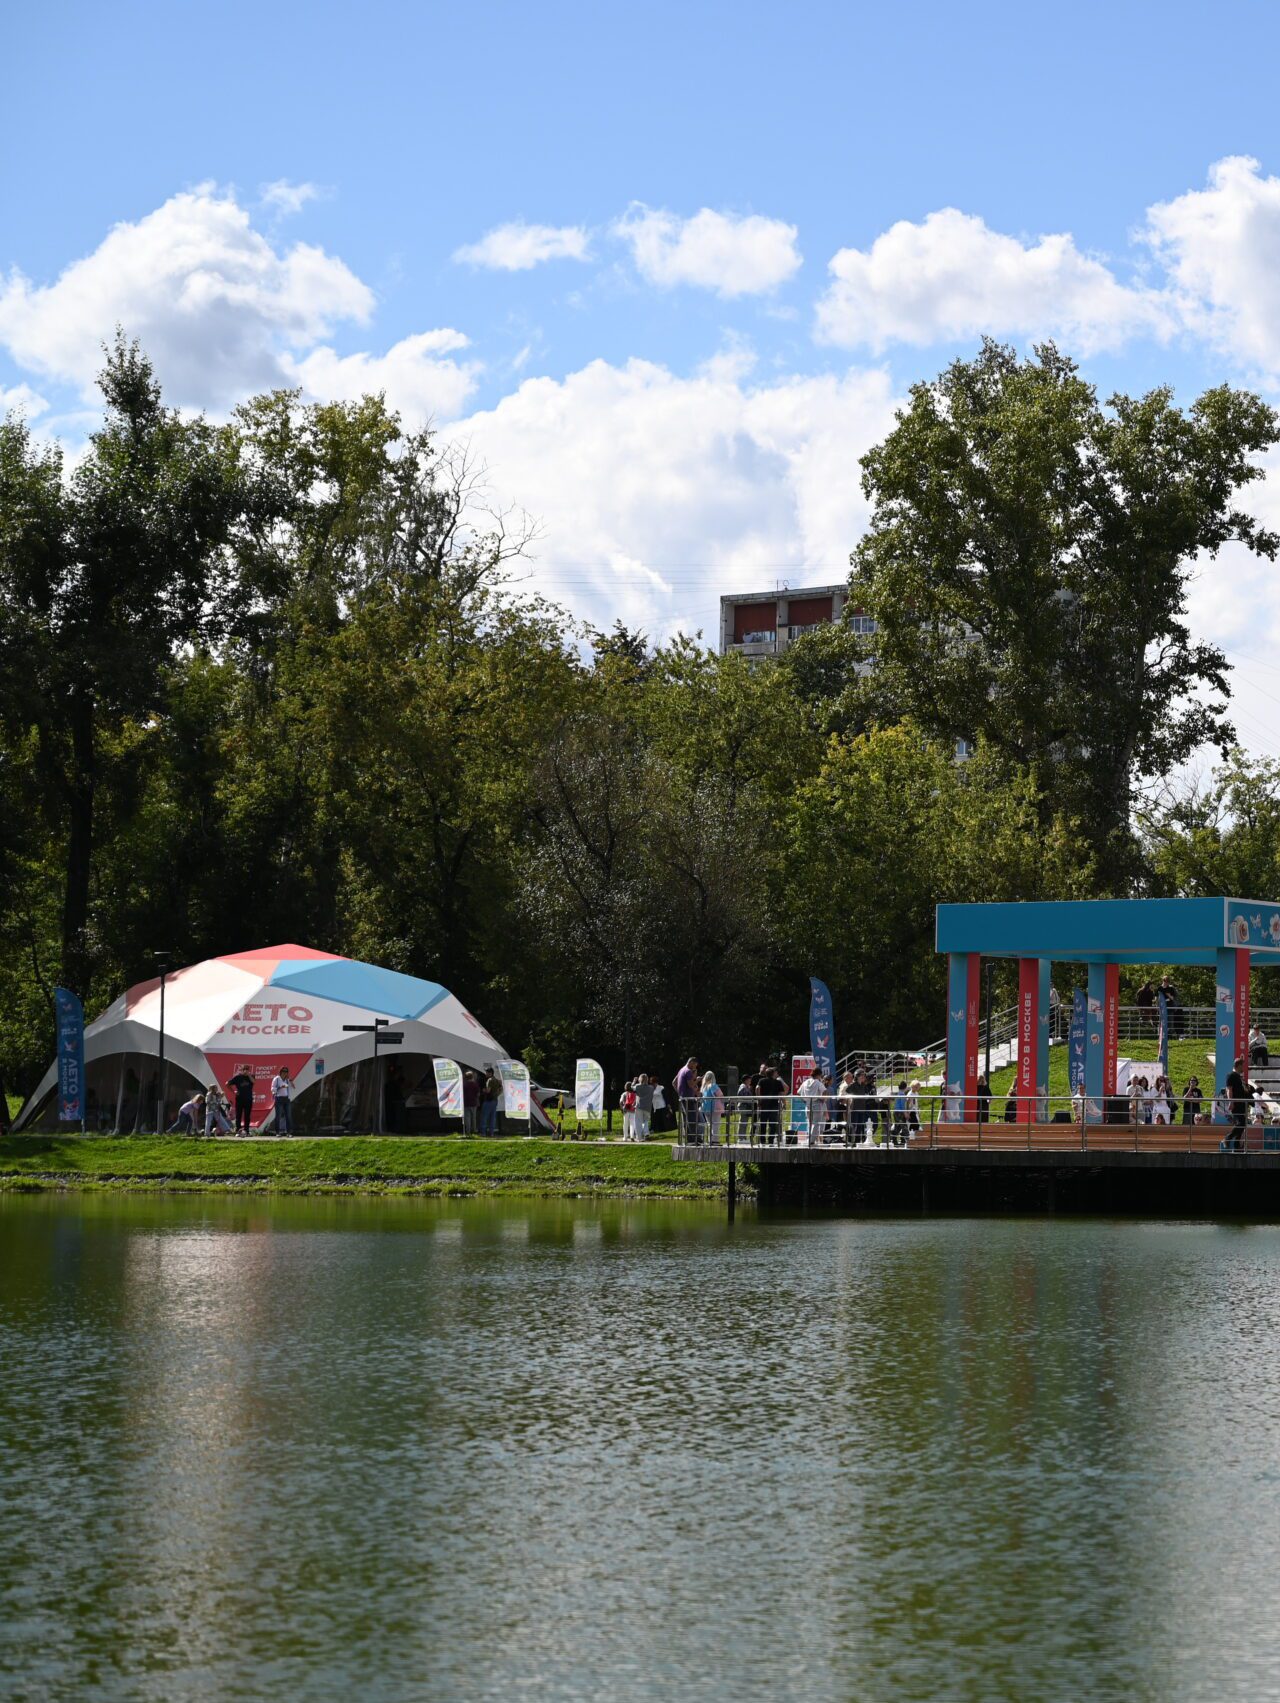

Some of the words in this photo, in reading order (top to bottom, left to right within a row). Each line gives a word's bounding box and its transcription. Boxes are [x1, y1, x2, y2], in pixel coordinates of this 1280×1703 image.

[231, 1025, 311, 1034] МОСКВЕ
[821, 1056, 830, 1075] ЛЕ
[69, 1058, 78, 1094] ЛЕТО
